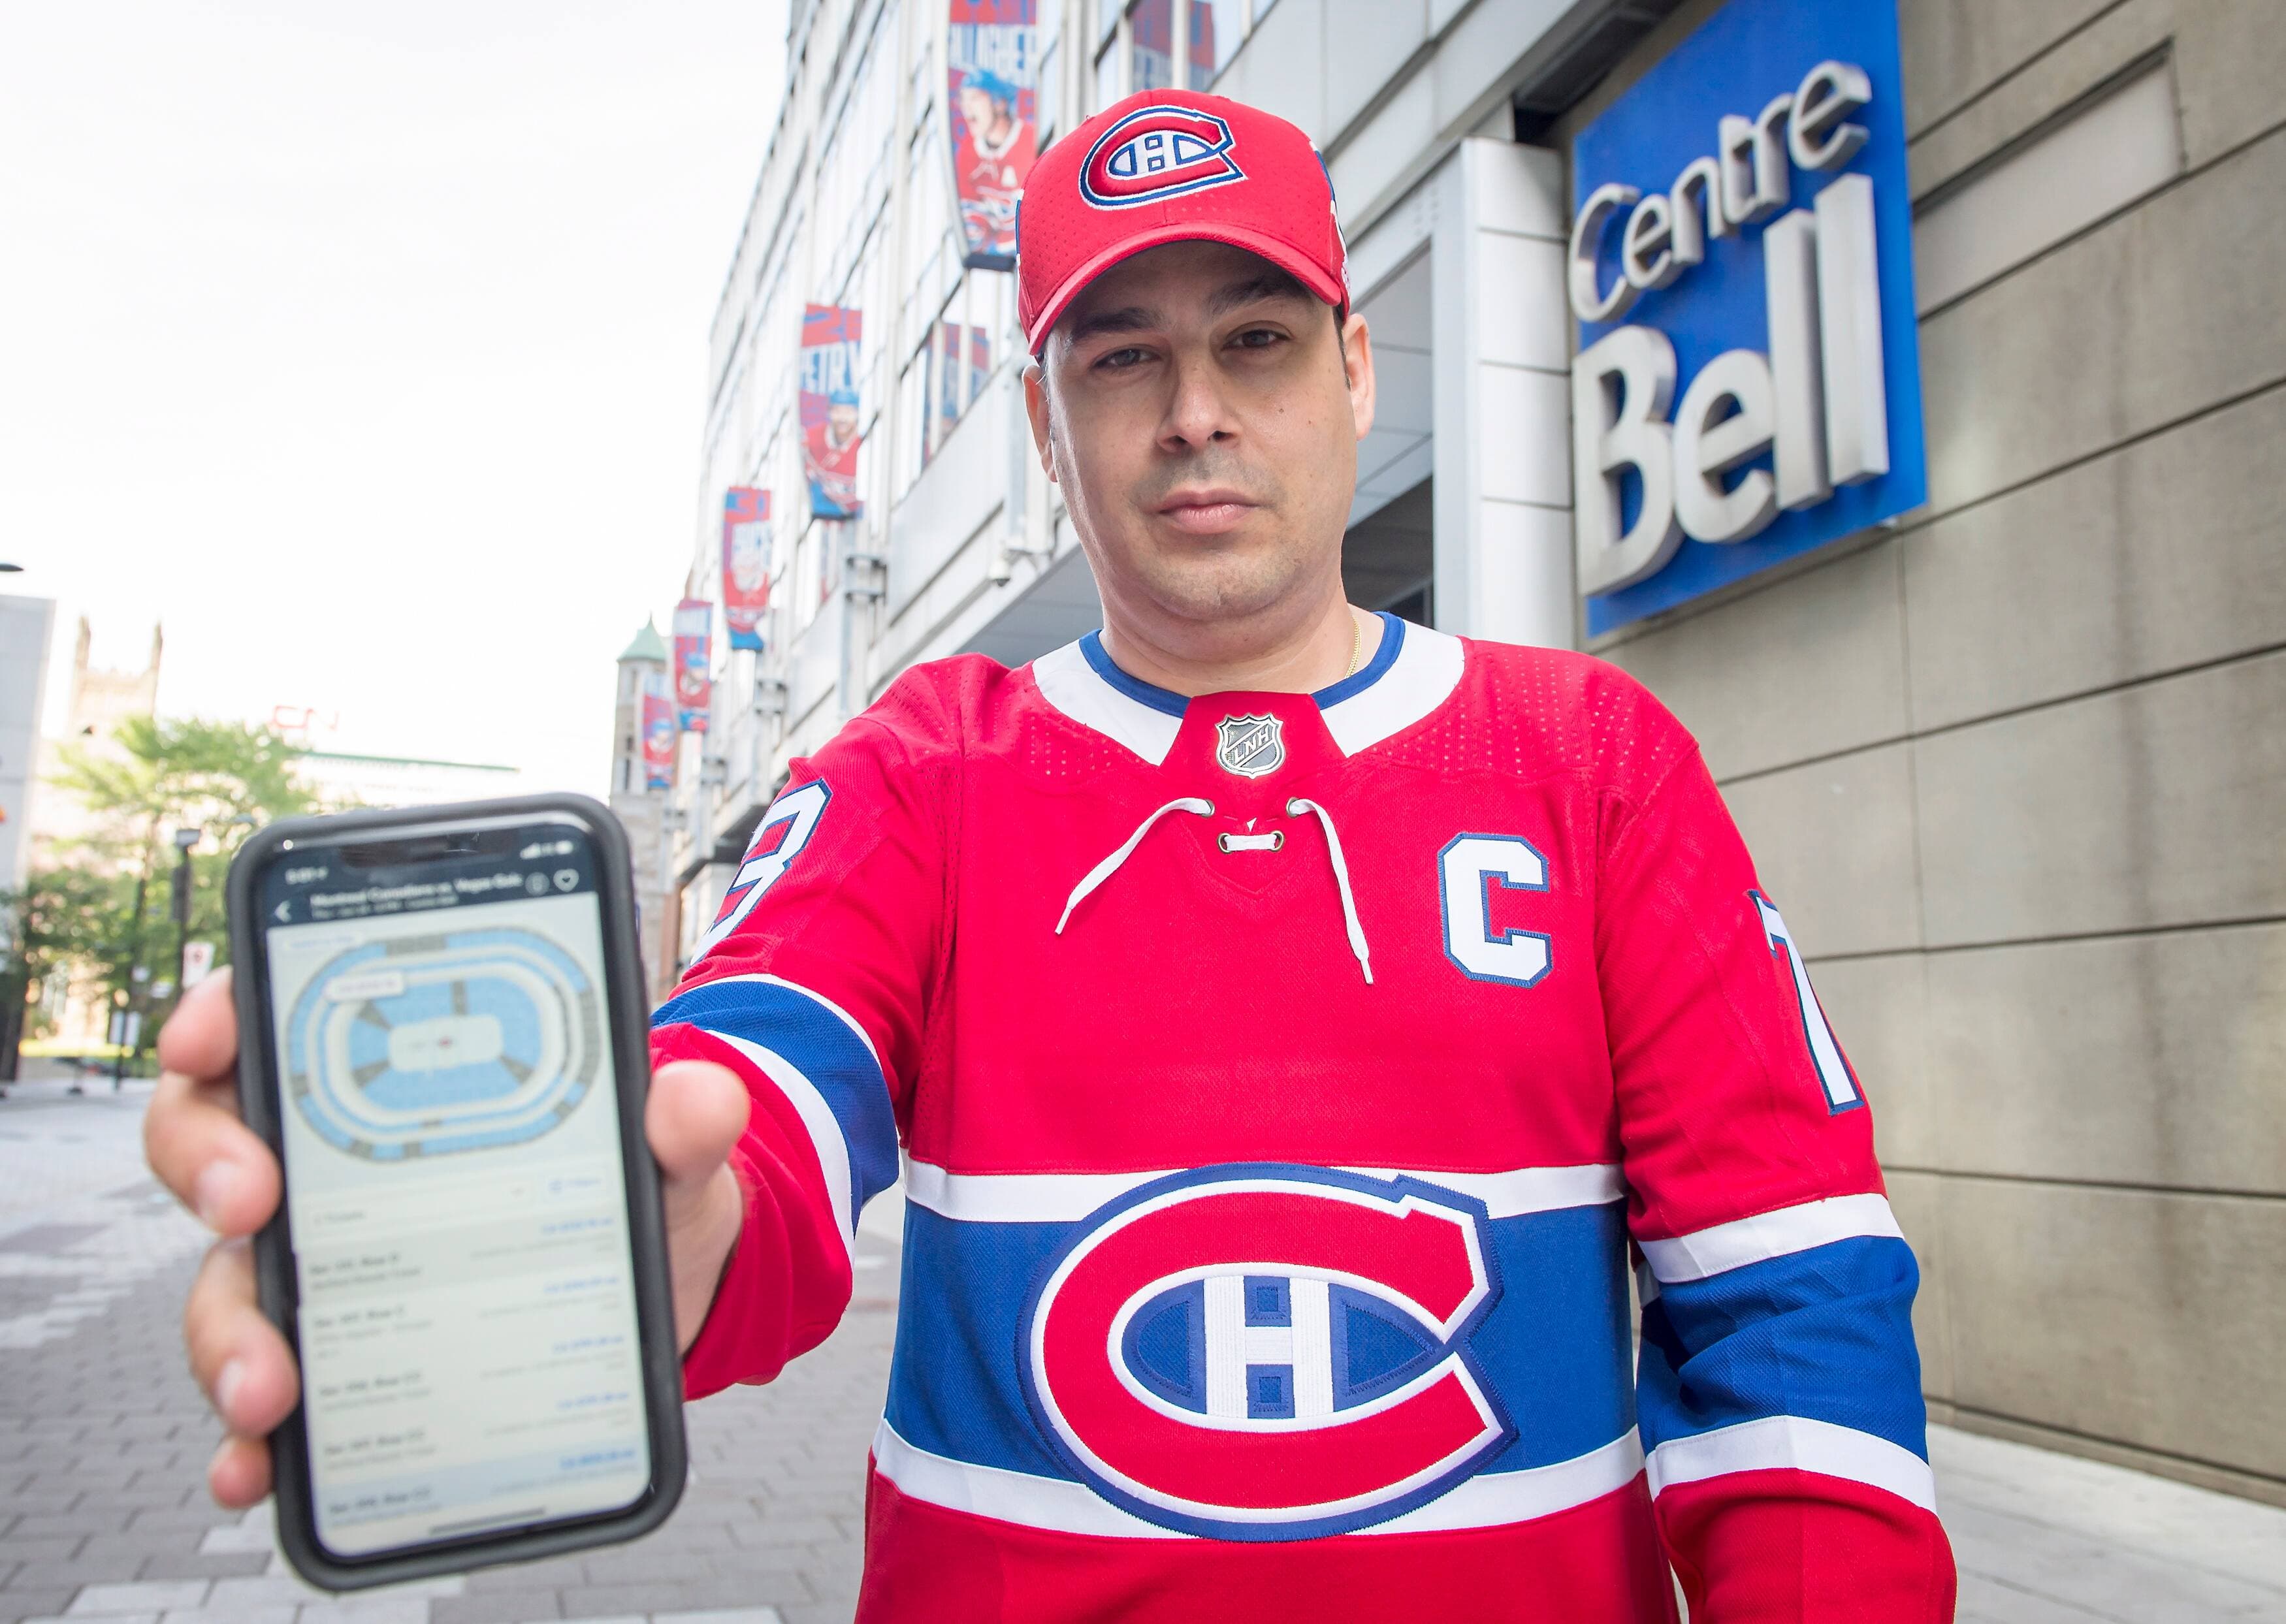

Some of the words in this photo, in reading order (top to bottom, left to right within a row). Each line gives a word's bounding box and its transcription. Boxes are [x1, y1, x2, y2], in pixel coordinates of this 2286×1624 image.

[1569, 60, 1872, 322] Centre
[1572, 173, 1890, 595] Bell
[1234, 725, 1270, 764] LNH
[1438, 831, 1554, 989] C
[1744, 889, 1865, 1117] 7
